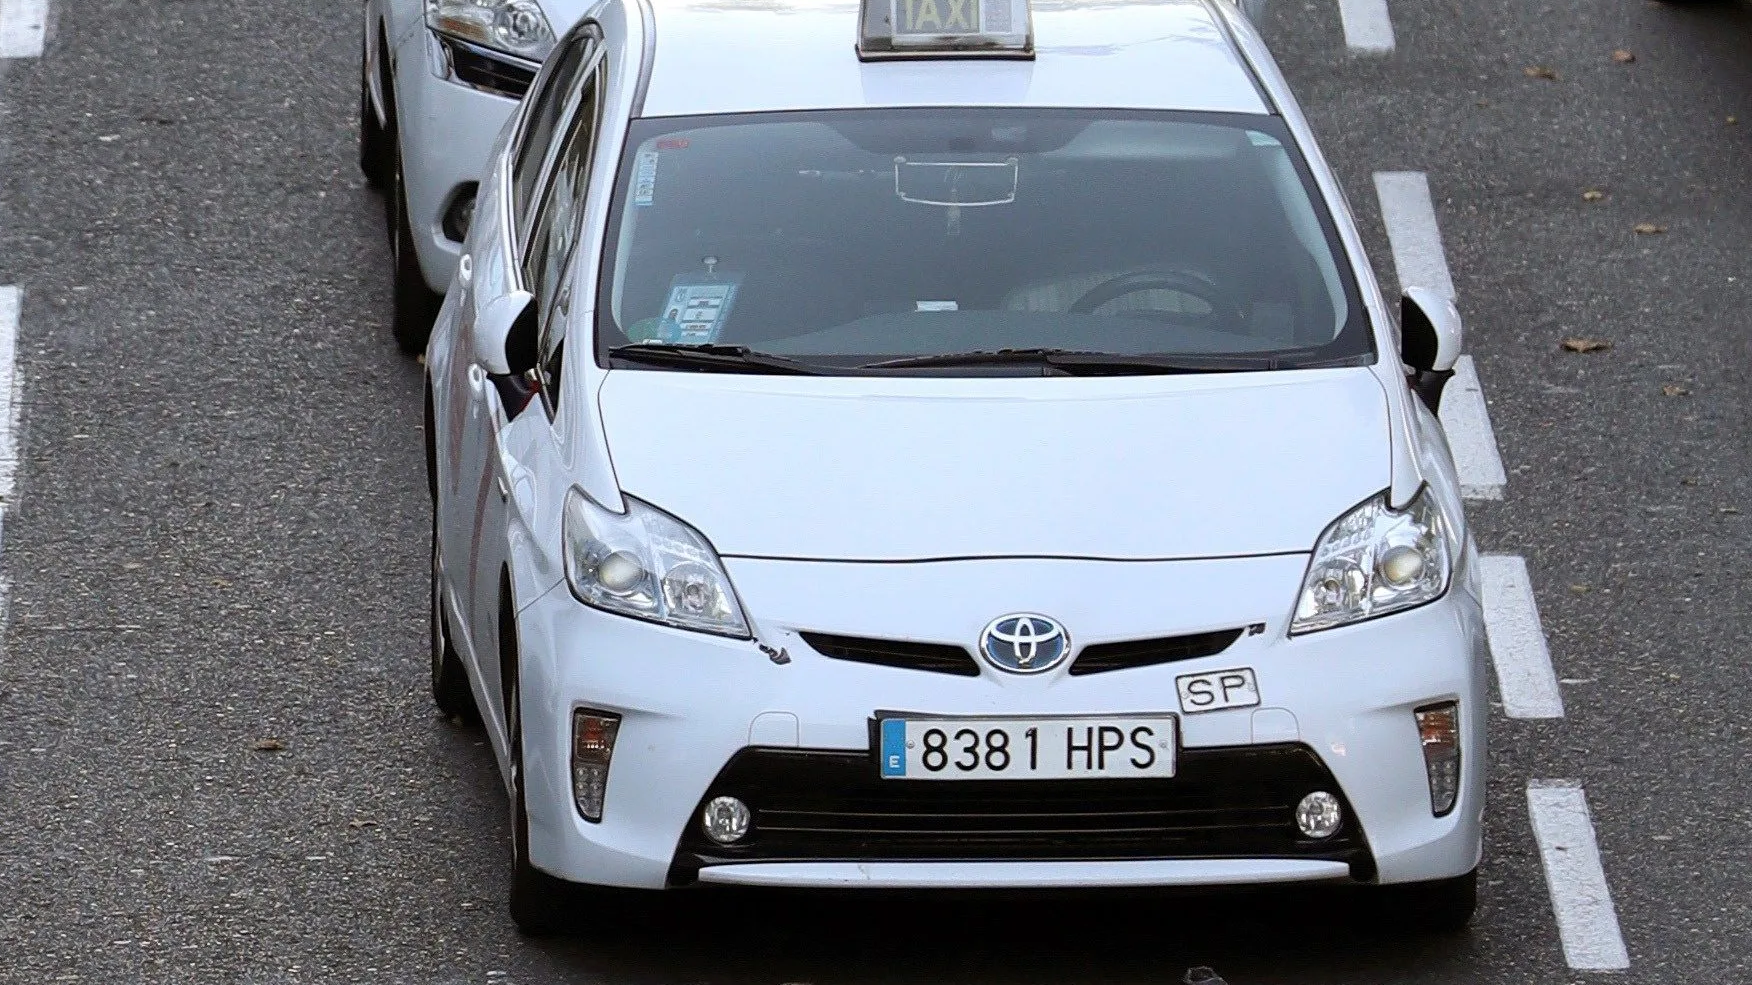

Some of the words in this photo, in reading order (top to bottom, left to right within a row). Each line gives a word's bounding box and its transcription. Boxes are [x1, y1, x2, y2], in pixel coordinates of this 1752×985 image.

[1186, 674, 1246, 707] SP
[889, 754, 900, 768] E
[921, 727, 1038, 772] 8381
[1067, 726, 1155, 771] HPS
